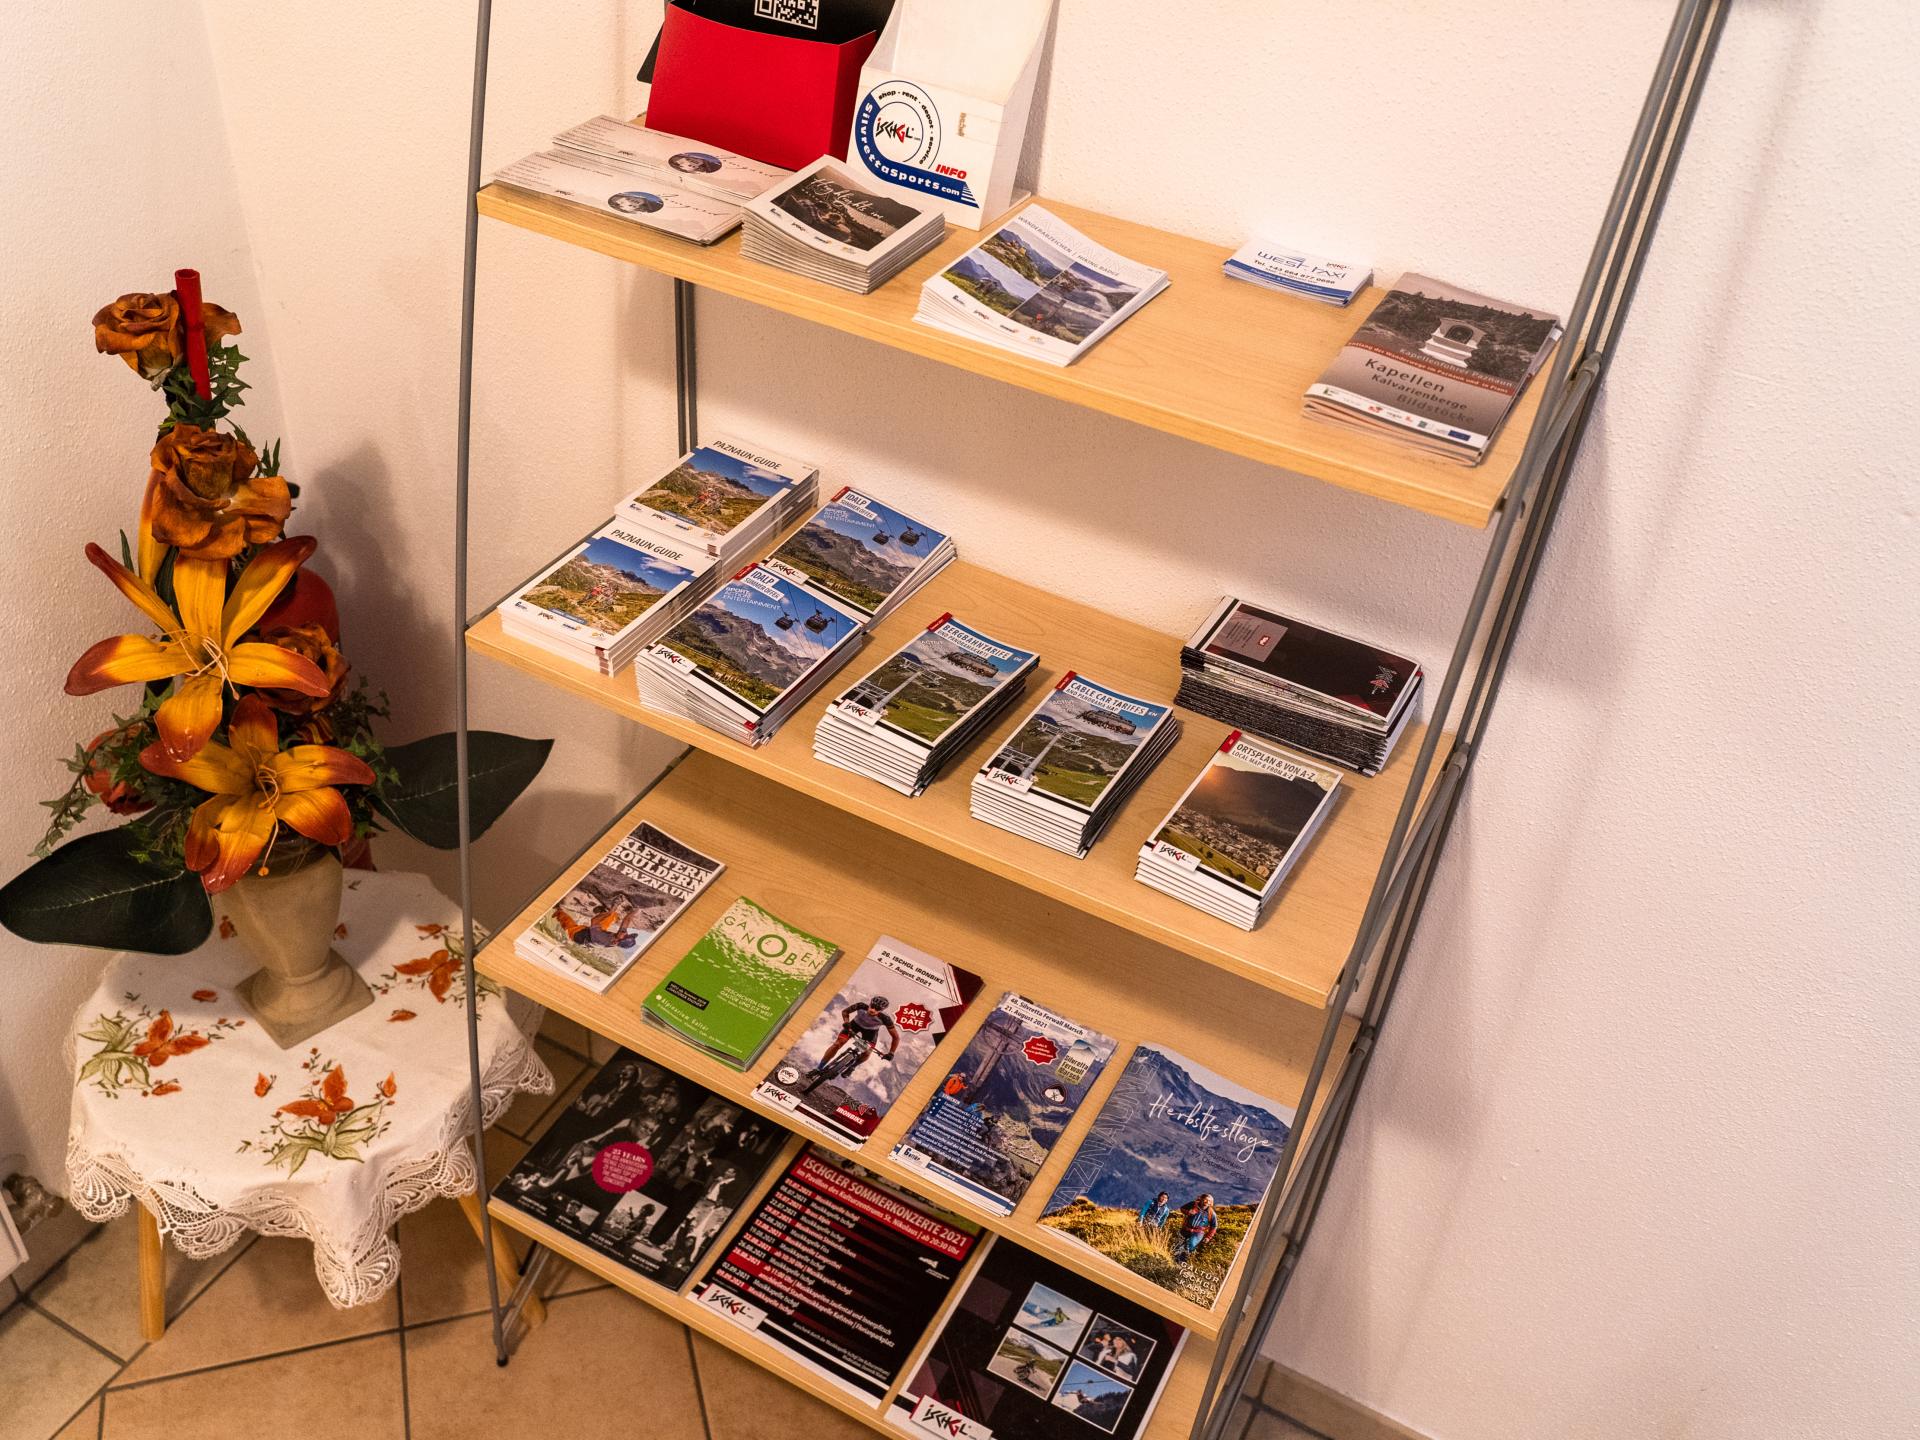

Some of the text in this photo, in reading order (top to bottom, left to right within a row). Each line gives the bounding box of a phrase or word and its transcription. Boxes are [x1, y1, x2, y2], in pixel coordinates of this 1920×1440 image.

[878, 90, 934, 165] shop rent depot service
[935, 164, 967, 180] INFO
[1366, 358, 1445, 392] Kapellen
[1372, 374, 1466, 410] Kalvarienberge
[1397, 394, 1473, 424] Bildstöcke
[713, 439, 782, 471] PAZNAUN GUIDE
[845, 493, 868, 506] IDALP
[611, 529, 683, 562] PAZNAUN GUIDE
[751, 571, 774, 585] IDALP
[942, 624, 1009, 660] BERGBAHNTARIFE
[1070, 682, 1095, 697] CABLE
[1096, 693, 1112, 704] CAR
[1112, 699, 1146, 715] TARIFFS
[1077, 692, 1107, 708] PANORAMA
[1231, 750, 1248, 760] LOCAL
[1248, 757, 1261, 766] MAP
[1266, 765, 1283, 775] FROM
[1236, 743, 1276, 764] ORTSPLAN
[1282, 762, 1300, 774] VON
[1300, 769, 1315, 780] A-Z
[611, 846, 701, 890] BOULDERN
[620, 837, 710, 882] KLETTERN
[621, 866, 690, 900] PAZNAUN
[880, 950, 944, 984] 26. ISCHGL IRONBIKE
[894, 966, 915, 979] August
[915, 976, 931, 986] 2021
[900, 1017, 924, 1027] DATE
[903, 1007, 927, 1018] SAVE
[1013, 1010, 1033, 1022] August
[1033, 1019, 1047, 1028] 2021
[1018, 1002, 1044, 1016] Silvretta
[1042, 1014, 1064, 1026] Ferwall
[1063, 1023, 1084, 1035] Marsch
[836, 1107, 865, 1125] IRONBIKE
[1149, 1092, 1274, 1163] Herbstfesttage
[803, 1158, 966, 1247] ISCHGLER SOMMERKONZERTE 2021
[804, 1173, 829, 1189] Pavillon
[827, 1185, 840, 1195] des
[839, 1191, 883, 1218] Kulturzentrums
[883, 1214, 893, 1223] St.
[892, 1218, 918, 1236] Nikolaus
[929, 1237, 948, 1250] 20:30
[946, 1245, 960, 1255] Uhr
